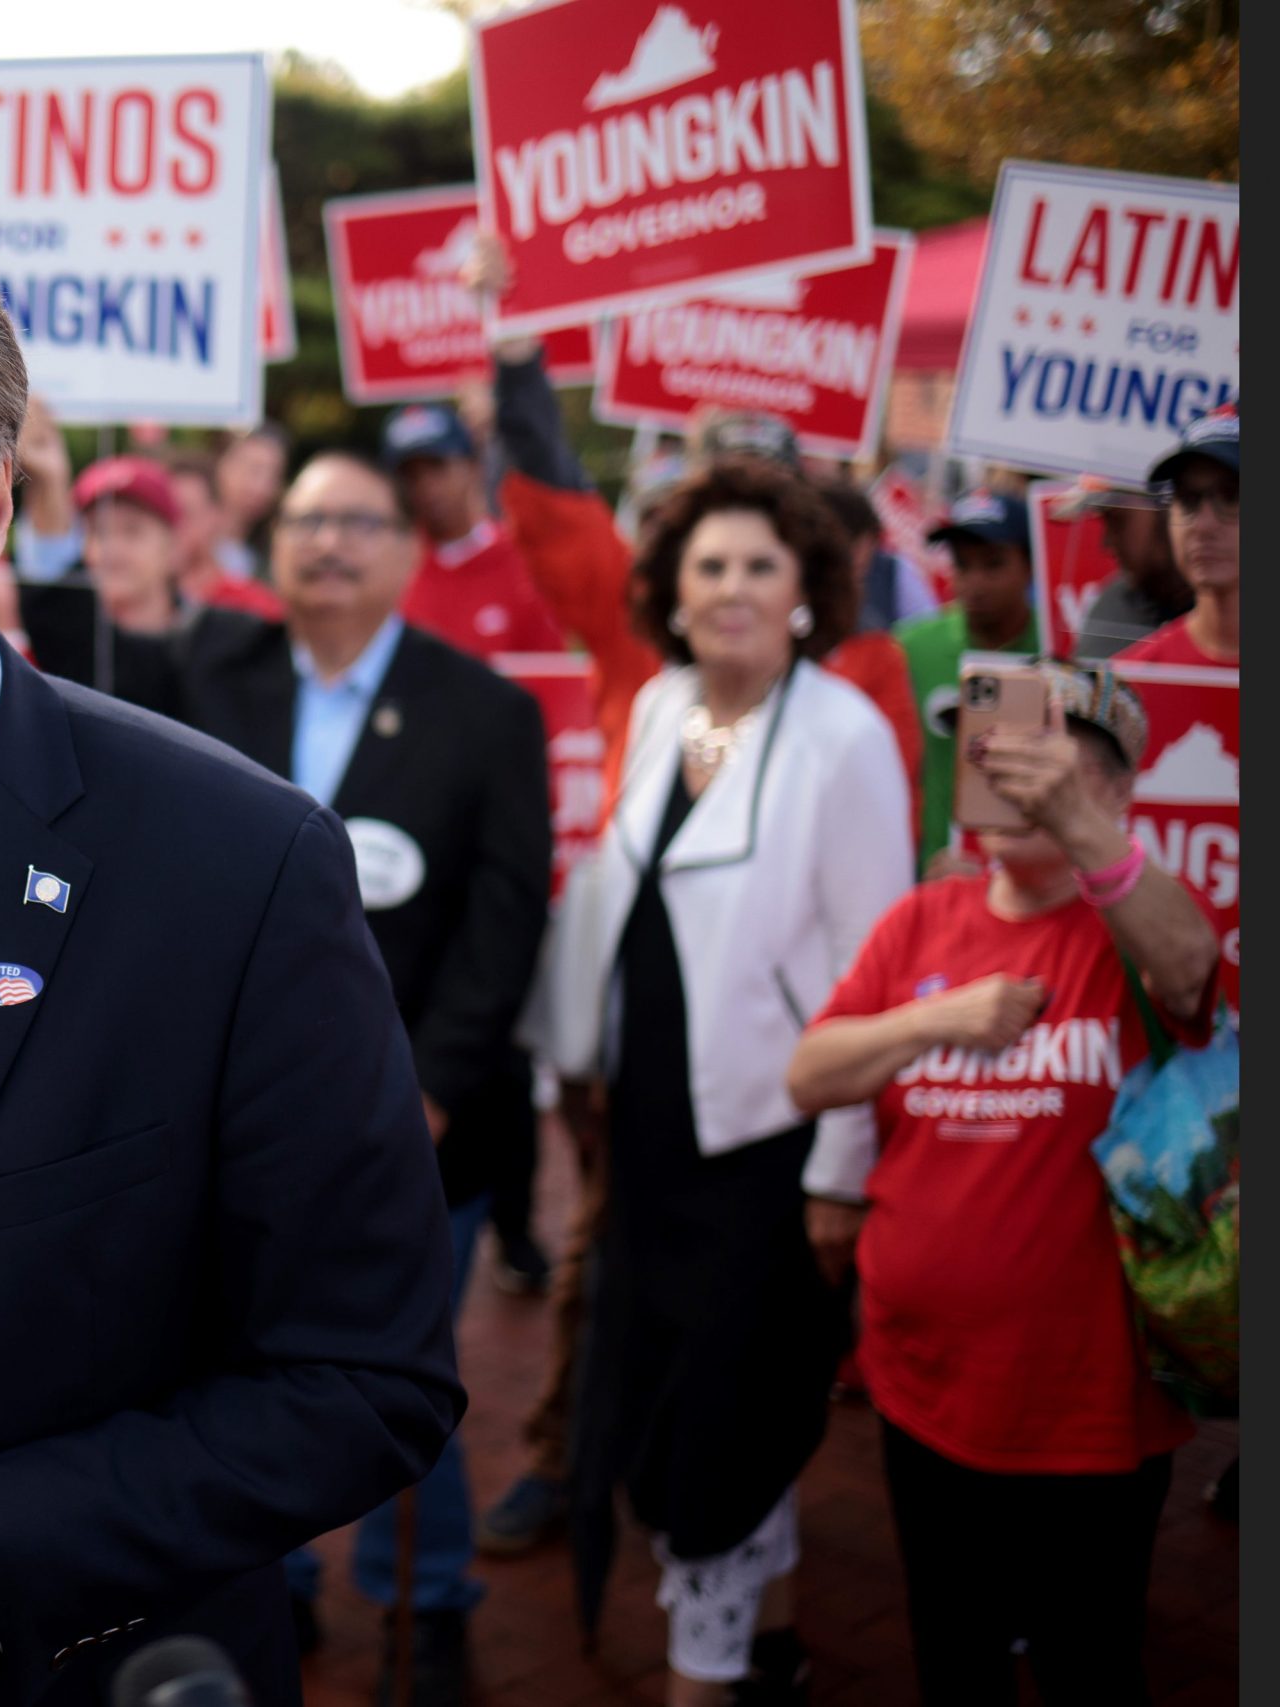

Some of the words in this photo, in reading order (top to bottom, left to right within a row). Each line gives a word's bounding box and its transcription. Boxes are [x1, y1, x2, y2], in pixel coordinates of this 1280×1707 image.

[495, 59, 840, 242] YOUNGKIN
[563, 183, 767, 263] GOVERNOR
[1019, 195, 1239, 312] LATIN
[1128, 316, 1200, 357] FOR
[1002, 341, 1231, 437] YOUNG
[904, 1086, 1065, 1119] GOVERNOR
